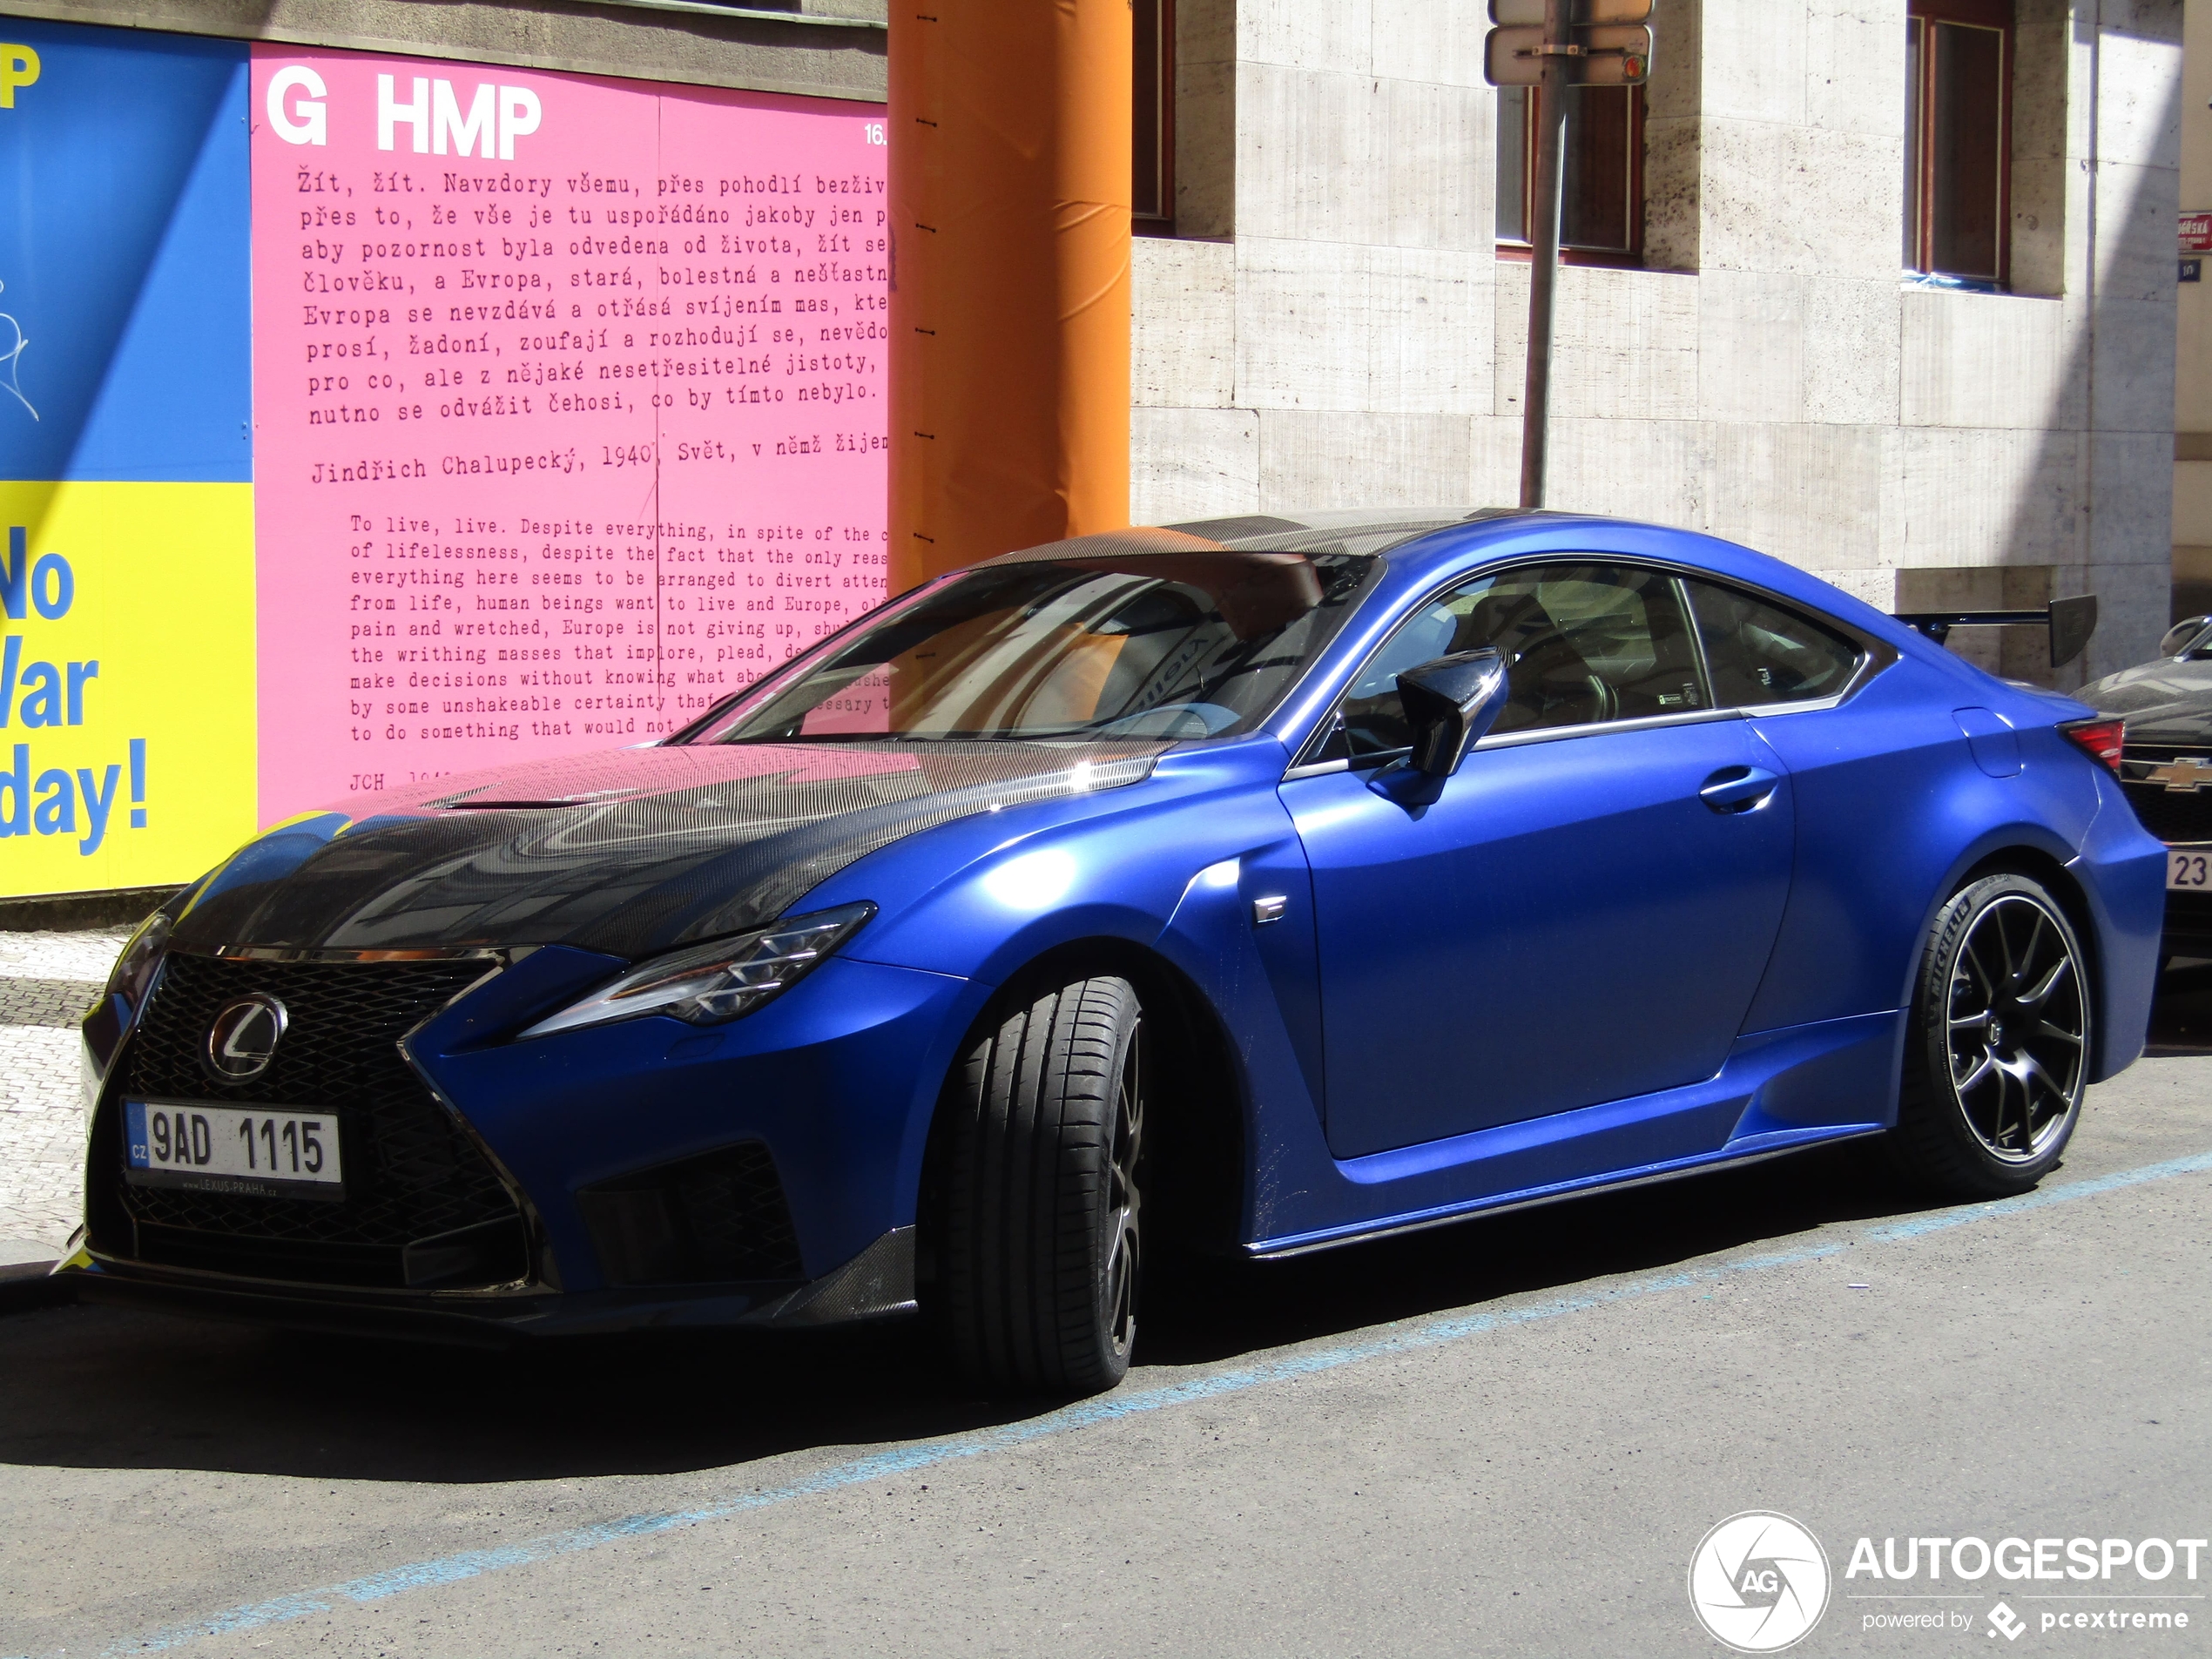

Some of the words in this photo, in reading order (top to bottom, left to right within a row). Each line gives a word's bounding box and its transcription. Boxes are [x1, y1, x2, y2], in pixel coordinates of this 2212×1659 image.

[266, 65, 327, 145] G
[378, 73, 542, 160] HMP
[298, 165, 352, 198] Žít,
[374, 172, 424, 192] žít.
[443, 172, 551, 198] Navzdory
[567, 172, 638, 198] všemu,
[657, 174, 705, 197] přes
[720, 174, 801, 197] pohodlí
[816, 175, 884, 193] bezživ
[300, 206, 355, 230] přes
[375, 206, 411, 230] to,
[433, 205, 456, 225] že
[474, 203, 511, 225] vše
[529, 205, 551, 228] je
[569, 206, 591, 224] tu
[607, 204, 729, 227] uspořádáno
[745, 205, 815, 228] jakoby
[830, 205, 863, 226] jen
[302, 239, 344, 264] aby
[362, 239, 485, 262] pozornost
[502, 238, 553, 261] byla
[570, 235, 669, 255] odvedena
[685, 235, 706, 253] od
[722, 235, 800, 257] života,
[819, 233, 850, 253] žít
[866, 239, 885, 253] se
[304, 270, 414, 295] člověku,
[462, 269, 551, 292] Evropa,
[571, 266, 642, 290] stará,
[659, 265, 756, 285] bolestná
[794, 261, 887, 282] nešťastn
[303, 306, 390, 328] Evropa
[408, 307, 432, 322] se
[450, 299, 556, 321] nevzdává
[597, 296, 671, 317] otřásá
[686, 293, 782, 318] svíjením
[795, 300, 838, 316] mas,
[855, 293, 887, 310] kte
[307, 335, 388, 363] prosí,
[409, 332, 500, 357] žadoní,
[520, 328, 608, 353] zoufají
[624, 334, 633, 347] a
[650, 324, 758, 347] rozhodují
[773, 329, 803, 347] se,
[820, 321, 887, 341] nevědo
[308, 376, 348, 396] pro
[368, 374, 404, 393] co,
[425, 368, 462, 387] ale
[507, 361, 583, 386] nějaké
[599, 354, 771, 379] nesetřesitelné
[786, 353, 874, 375] jistoty,
[310, 404, 379, 425] nutno
[399, 405, 422, 421] se
[441, 395, 531, 418] odvážit
[550, 391, 633, 414] čehosi,
[651, 395, 673, 407] co
[688, 388, 711, 410] by
[726, 384, 783, 404] tímto
[799, 382, 875, 404] nebylo.
[312, 459, 426, 483] Jindřich
[442, 448, 584, 475] Chalupecký,
[602, 444, 662, 469] 1940,
[678, 440, 734, 462] Svět,
[776, 435, 821, 455] němž
[351, 515, 371, 531] To
[387, 516, 438, 536] live,
[455, 518, 505, 533] live.
[521, 518, 592, 537] Despite
[606, 523, 713, 542] everything,
[728, 524, 746, 538] in
[758, 525, 803, 542] spite
[815, 526, 833, 541] of
[844, 527, 869, 541] the
[351, 542, 373, 558] of
[387, 543, 527, 563] lifelessness,
[543, 543, 613, 563] despite
[627, 546, 654, 561] the
[667, 547, 705, 562] fact
[718, 548, 754, 563] that
[767, 549, 793, 563] the
[806, 550, 841, 568] only
[853, 554, 887, 564] reas
[352, 569, 464, 588] everything
[476, 570, 518, 584] here
[532, 573, 582, 584] seems
[596, 570, 613, 584] to
[626, 570, 644, 585] be
[659, 571, 735, 590] arranged
[747, 573, 764, 586] to
[776, 572, 831, 587] divert
[842, 573, 887, 588] atten
[350, 595, 395, 610] from
[410, 595, 461, 614] life,
[476, 595, 529, 610] human
[542, 595, 603, 613] beings
[616, 596, 655, 610] want
[668, 596, 685, 610] to
[698, 597, 735, 611] live
[747, 596, 774, 611] and
[785, 597, 847, 615] Europe,
[351, 621, 395, 640] pain
[409, 619, 441, 636] and
[455, 619, 548, 638] wretched,
[563, 619, 624, 637] Europe
[637, 620, 654, 634] is
[667, 621, 695, 635] not
[706, 620, 765, 638] giving
[776, 624, 800, 638] up,
[351, 647, 383, 663] the
[398, 646, 486, 664] writhing
[498, 649, 561, 661] masses
[575, 644, 613, 659] that
[626, 644, 704, 664] implore,
[717, 643, 772, 663] plead,
[350, 673, 395, 689] make
[409, 671, 507, 687] decisions
[520, 671, 592, 685] without
[604, 668, 676, 688] knowing
[687, 669, 725, 684] what
[351, 699, 373, 719] by
[387, 702, 428, 714] some
[442, 695, 561, 713] unshakeable
[574, 692, 665, 711] certainty
[351, 726, 371, 741] to
[386, 724, 406, 739] do
[421, 722, 519, 740] something
[532, 720, 571, 736] that
[584, 718, 635, 734] would
[646, 718, 674, 732] not
[350, 773, 384, 791] JCH
[2175, 857, 2212, 886] 23
[1929, 897, 1972, 998] MICHELIN
[132, 1145, 147, 1160] CZ
[152, 1112, 212, 1165] 9AD
[239, 1118, 324, 1173] 1115
